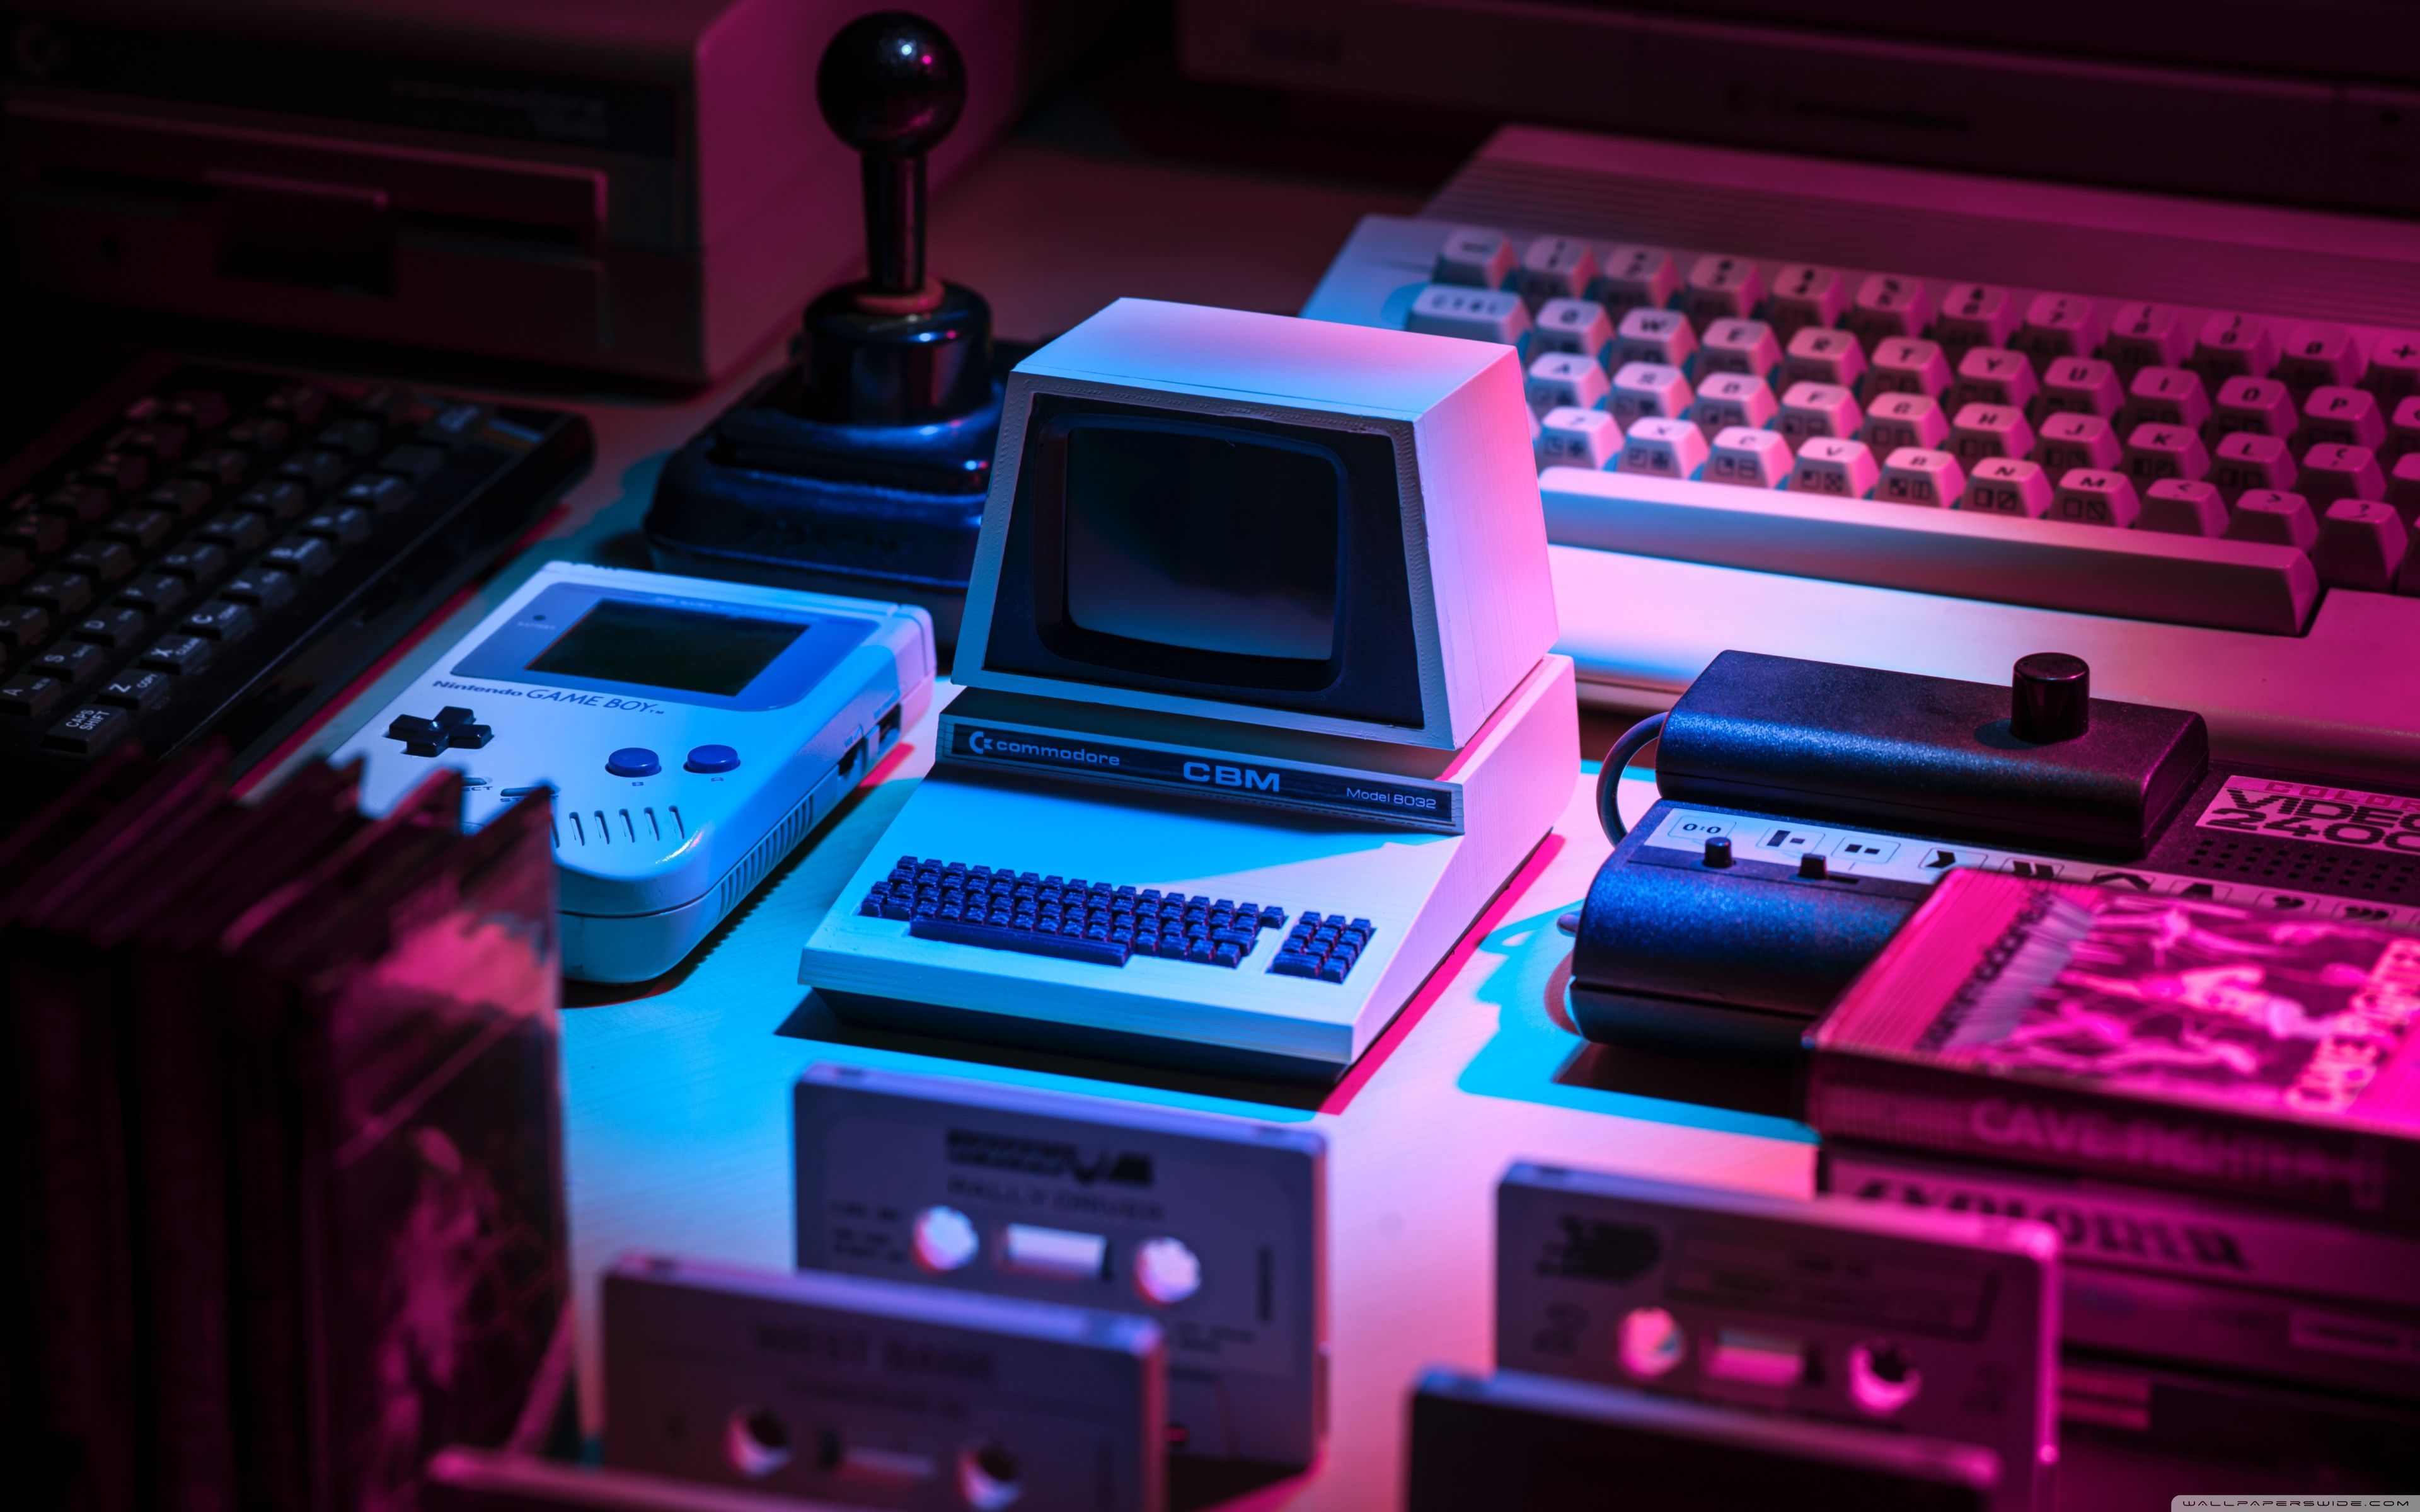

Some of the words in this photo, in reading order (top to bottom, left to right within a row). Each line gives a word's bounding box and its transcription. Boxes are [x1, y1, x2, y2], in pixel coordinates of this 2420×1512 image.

[108, 683, 132, 692] Z
[432, 680, 523, 697] Nintendo
[527, 689, 604, 707] GAME
[603, 697, 659, 713] BOY
[66, 709, 95, 728] CAPS
[79, 711, 110, 731] SHIFT
[997, 739, 1121, 767] commodore
[1183, 760, 1281, 793] CBM
[1346, 787, 1391, 805] Model
[1393, 793, 1438, 810] 8032
